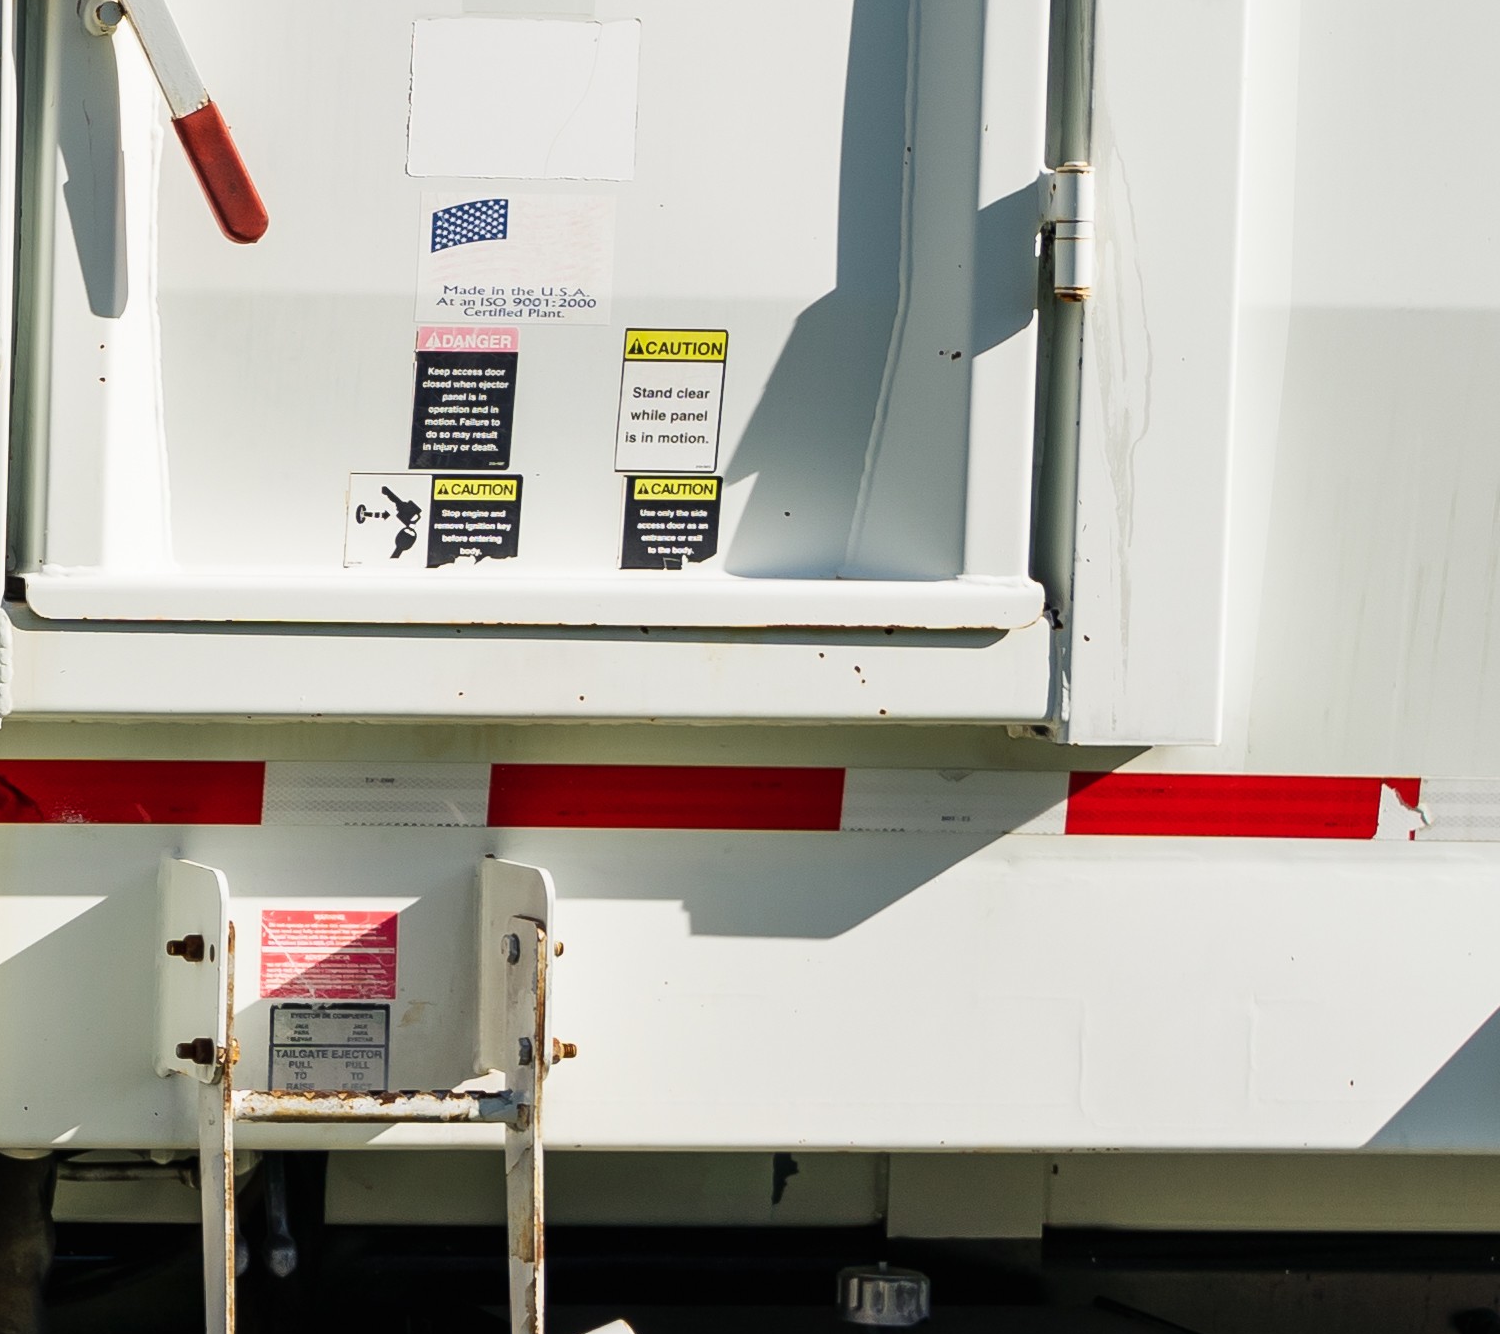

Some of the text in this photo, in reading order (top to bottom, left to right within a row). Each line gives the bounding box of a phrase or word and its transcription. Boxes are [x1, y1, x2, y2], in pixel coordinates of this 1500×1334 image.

[443, 284, 591, 298] Made in the U.S.A.
[435, 297, 597, 309] At an ISO 9001:2000
[463, 307, 565, 319] Certified Plant.
[442, 334, 512, 349] DANGER
[645, 341, 723, 356] CAUTION
[427, 366, 506, 377] Keep access door
[422, 379, 510, 391] closed when ejector
[441, 392, 488, 402] panel is in
[632, 386, 711, 400] Stand clear
[428, 405, 500, 415] operation and in
[630, 409, 708, 424] while panel
[424, 418, 501, 427] motion. Failure to
[425, 430, 499, 441] do so may result
[624, 432, 710, 444] is in motion.
[422, 442, 499, 453] in injury or death.
[451, 483, 514, 496] CAUTION
[651, 483, 714, 496] CAUTION
[441, 509, 461, 520] Stop
[274, 1049, 383, 1059] TAILGATE EJECTOR
[288, 1060, 313, 1069] PULL
[345, 1061, 370, 1069] PULL
[293, 1071, 308, 1080] TO
[350, 1072, 364, 1080] TO
